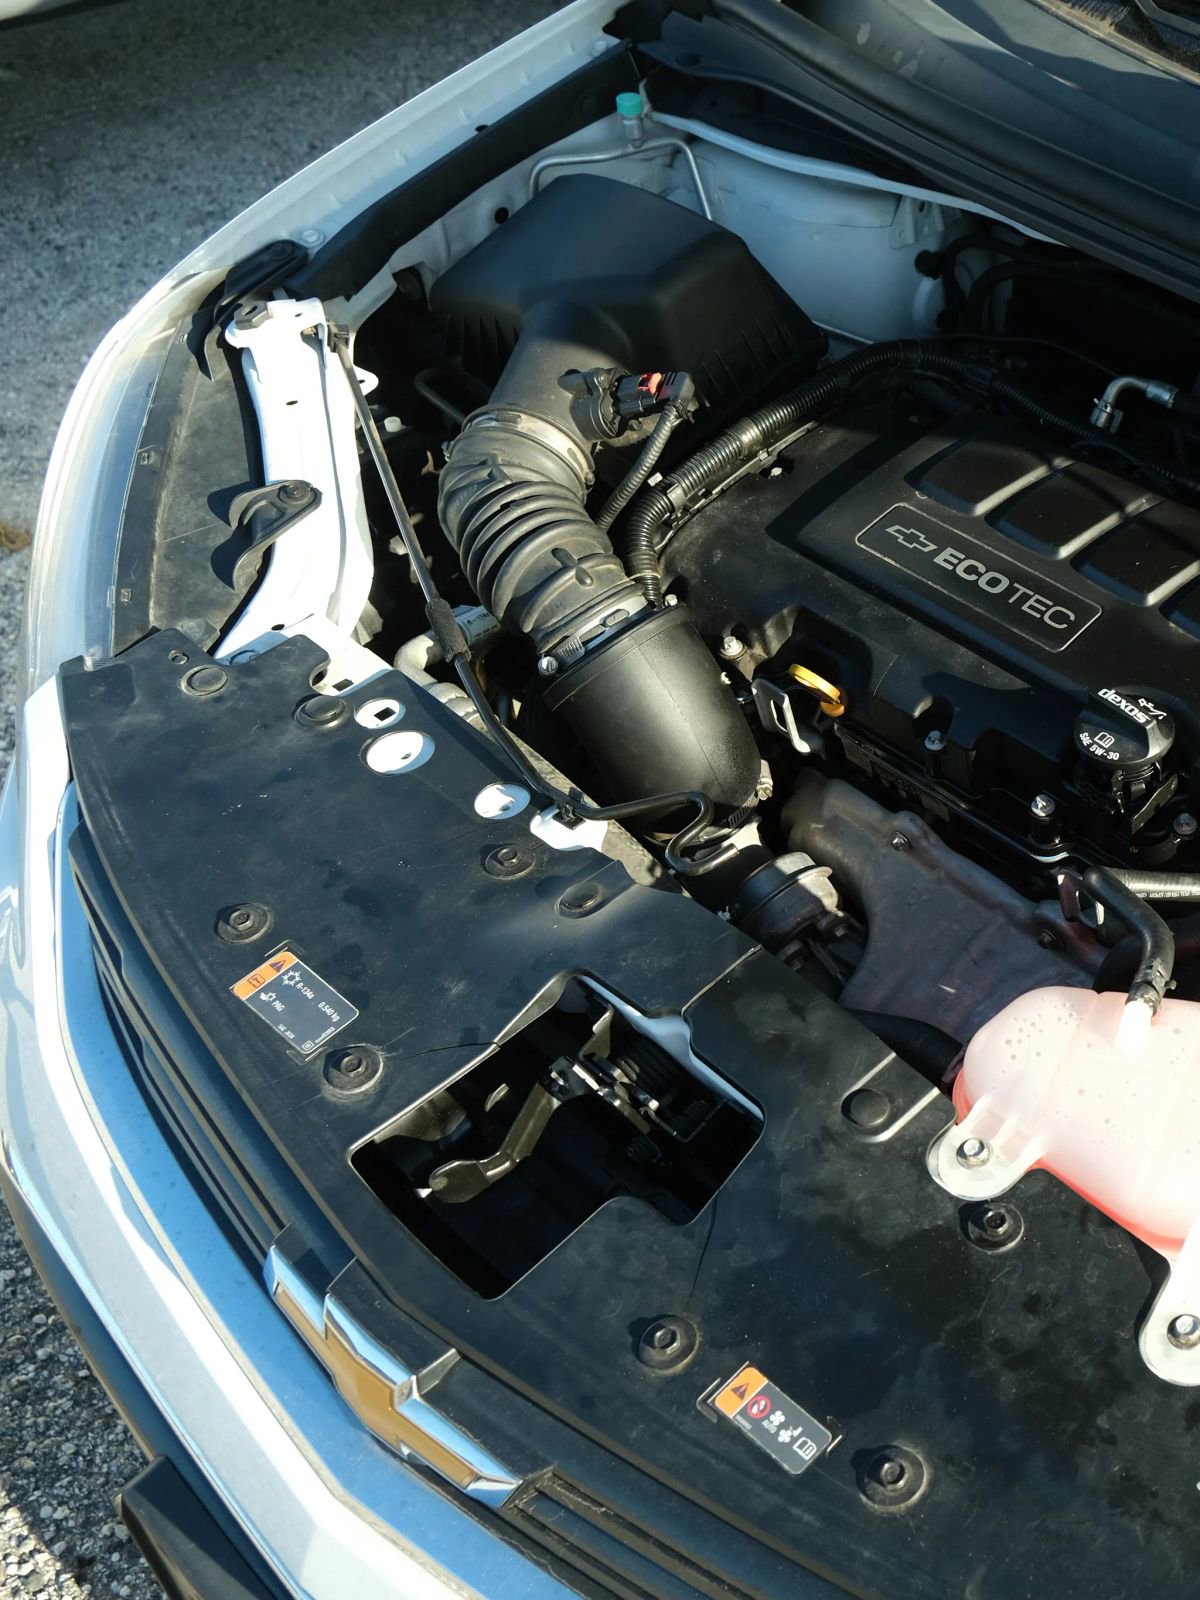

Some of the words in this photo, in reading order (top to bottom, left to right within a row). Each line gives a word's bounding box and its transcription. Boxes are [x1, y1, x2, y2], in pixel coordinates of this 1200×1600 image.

[1097, 688, 1151, 724] dexos
[1079, 732, 1093, 747] SAE
[1089, 744, 1120, 761] 5W-30
[271, 1001, 285, 1012] PAG
